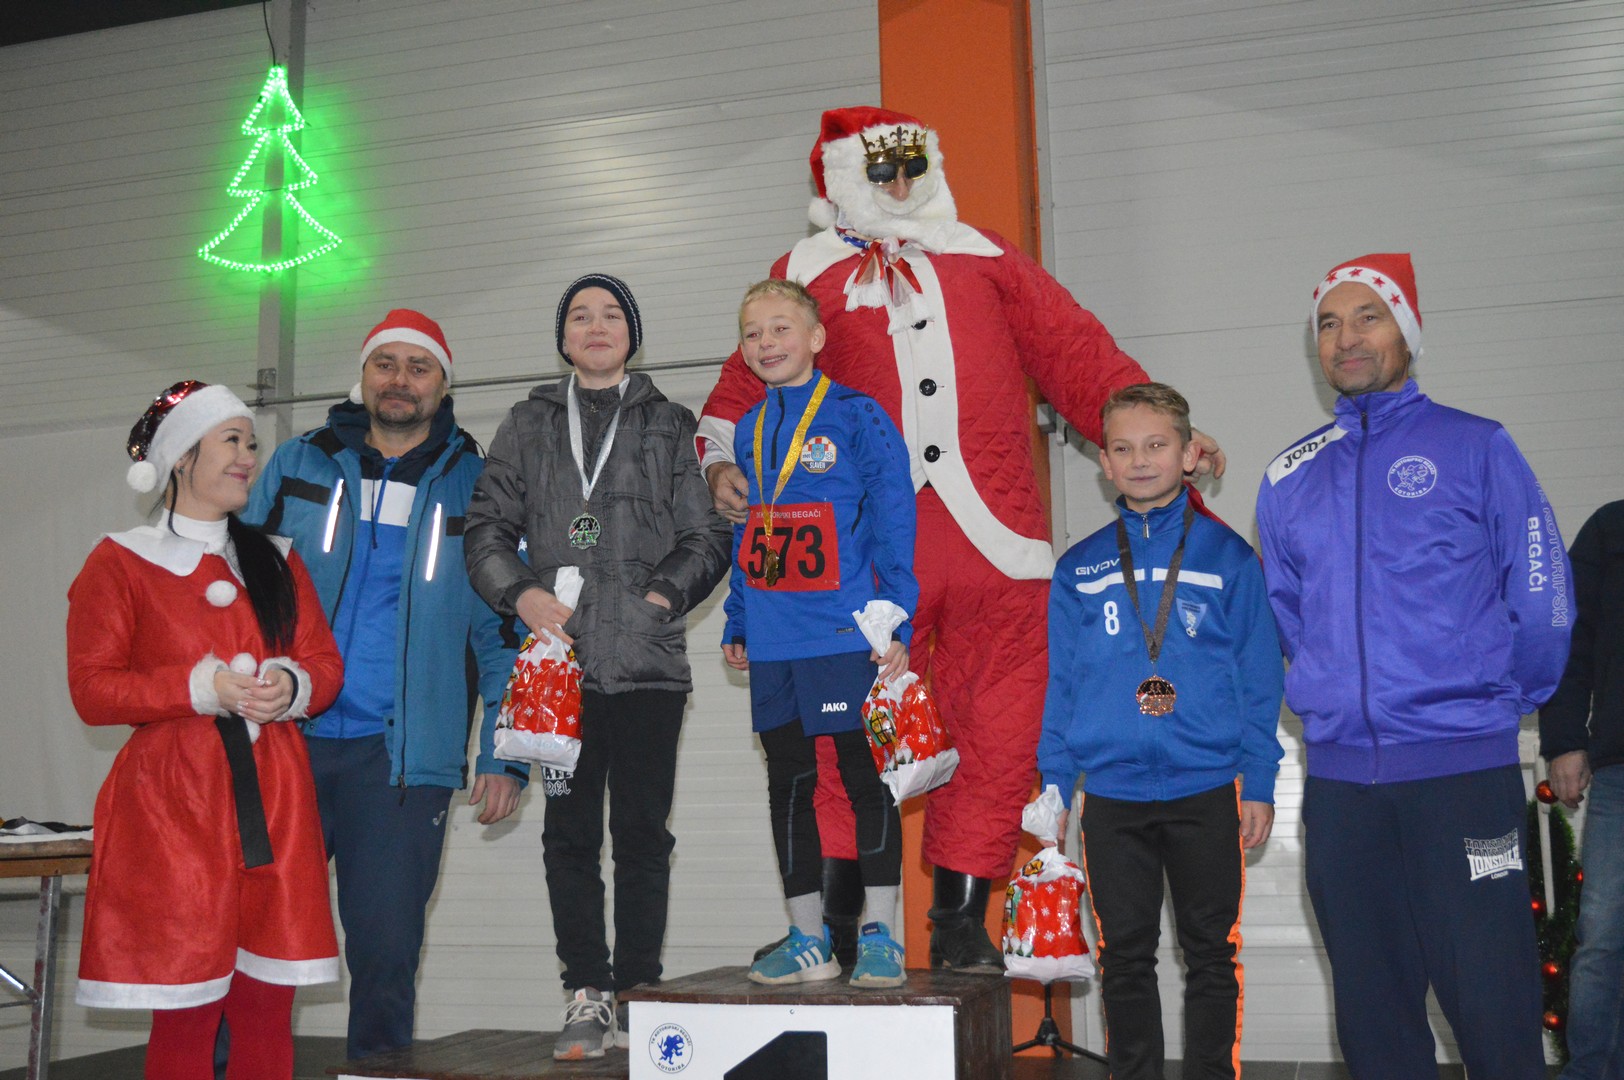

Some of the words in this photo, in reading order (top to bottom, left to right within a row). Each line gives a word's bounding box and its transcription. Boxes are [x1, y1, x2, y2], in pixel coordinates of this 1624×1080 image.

[792, 509, 821, 518] BEGAČI
[748, 524, 825, 578] 573
[1527, 516, 1548, 592] BEGAČI
[1075, 557, 1120, 576] GIVOV
[1103, 600, 1120, 636] 8
[821, 701, 848, 713] JAKO
